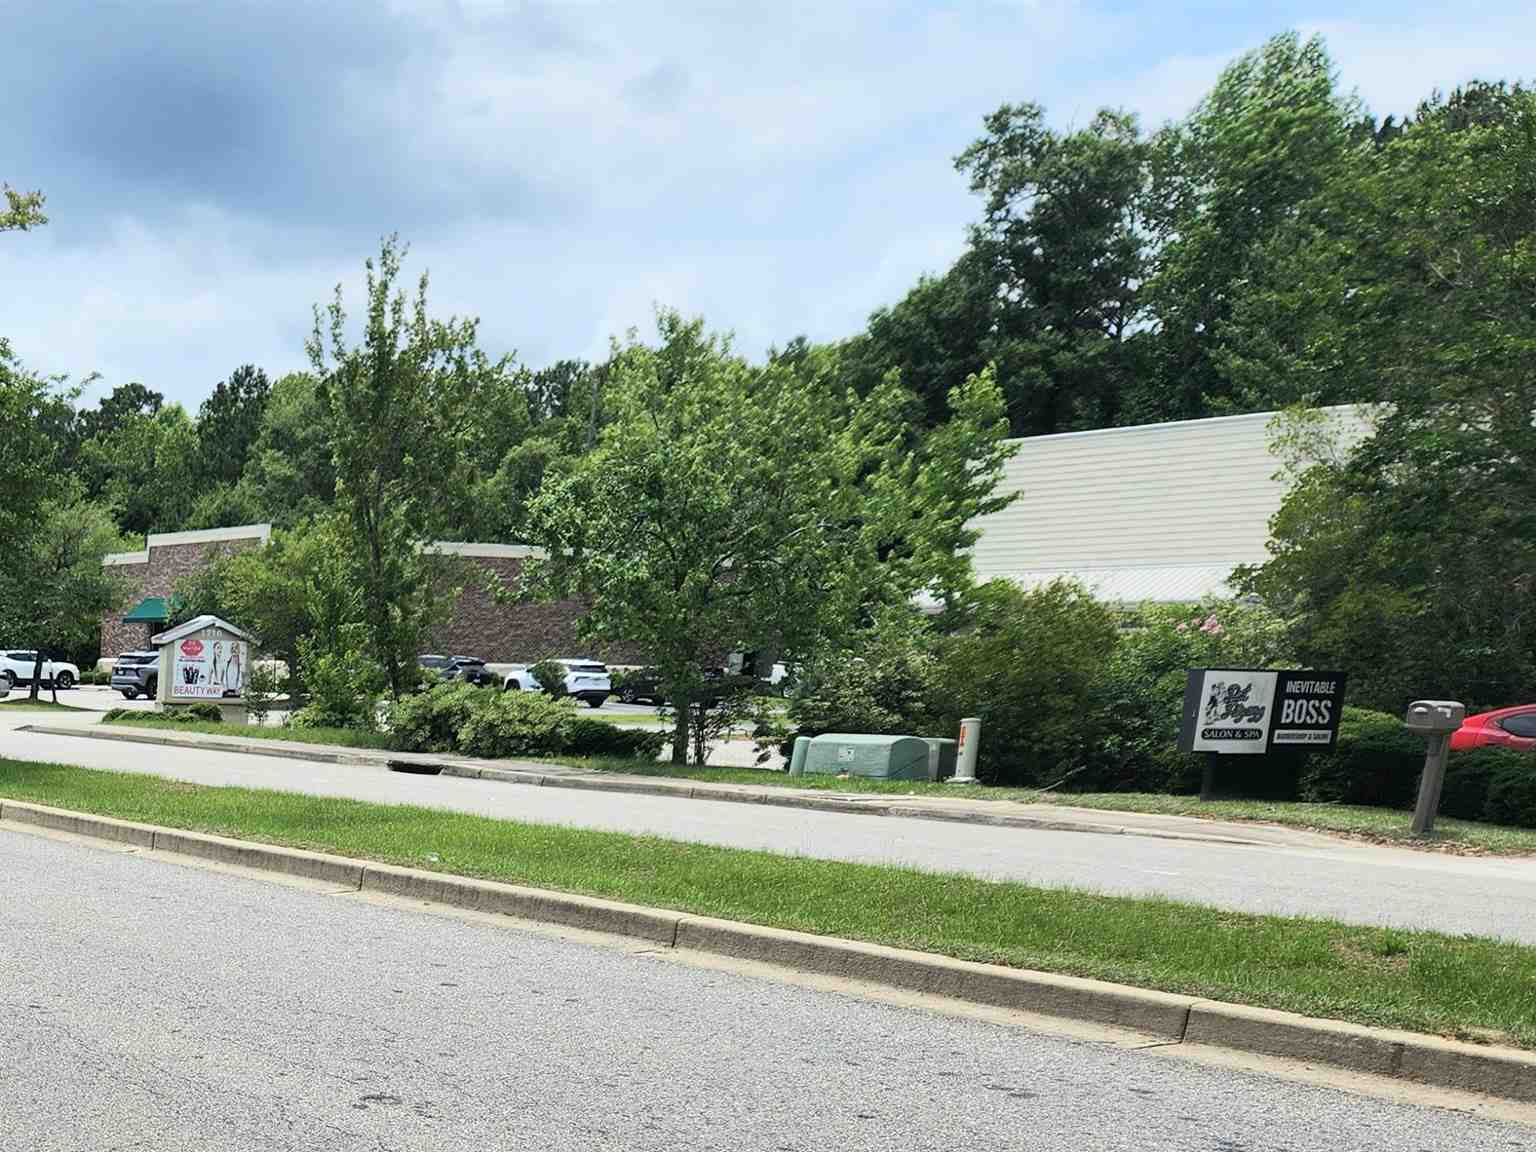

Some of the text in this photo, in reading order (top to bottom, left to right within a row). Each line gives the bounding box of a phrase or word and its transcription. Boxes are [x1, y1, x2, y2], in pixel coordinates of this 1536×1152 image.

[174, 685, 206, 696] BEAUTY
[1286, 680, 1337, 694] INEVITABLE
[1280, 698, 1333, 724] BOSS
[1203, 728, 1261, 738] SALON & SPA
